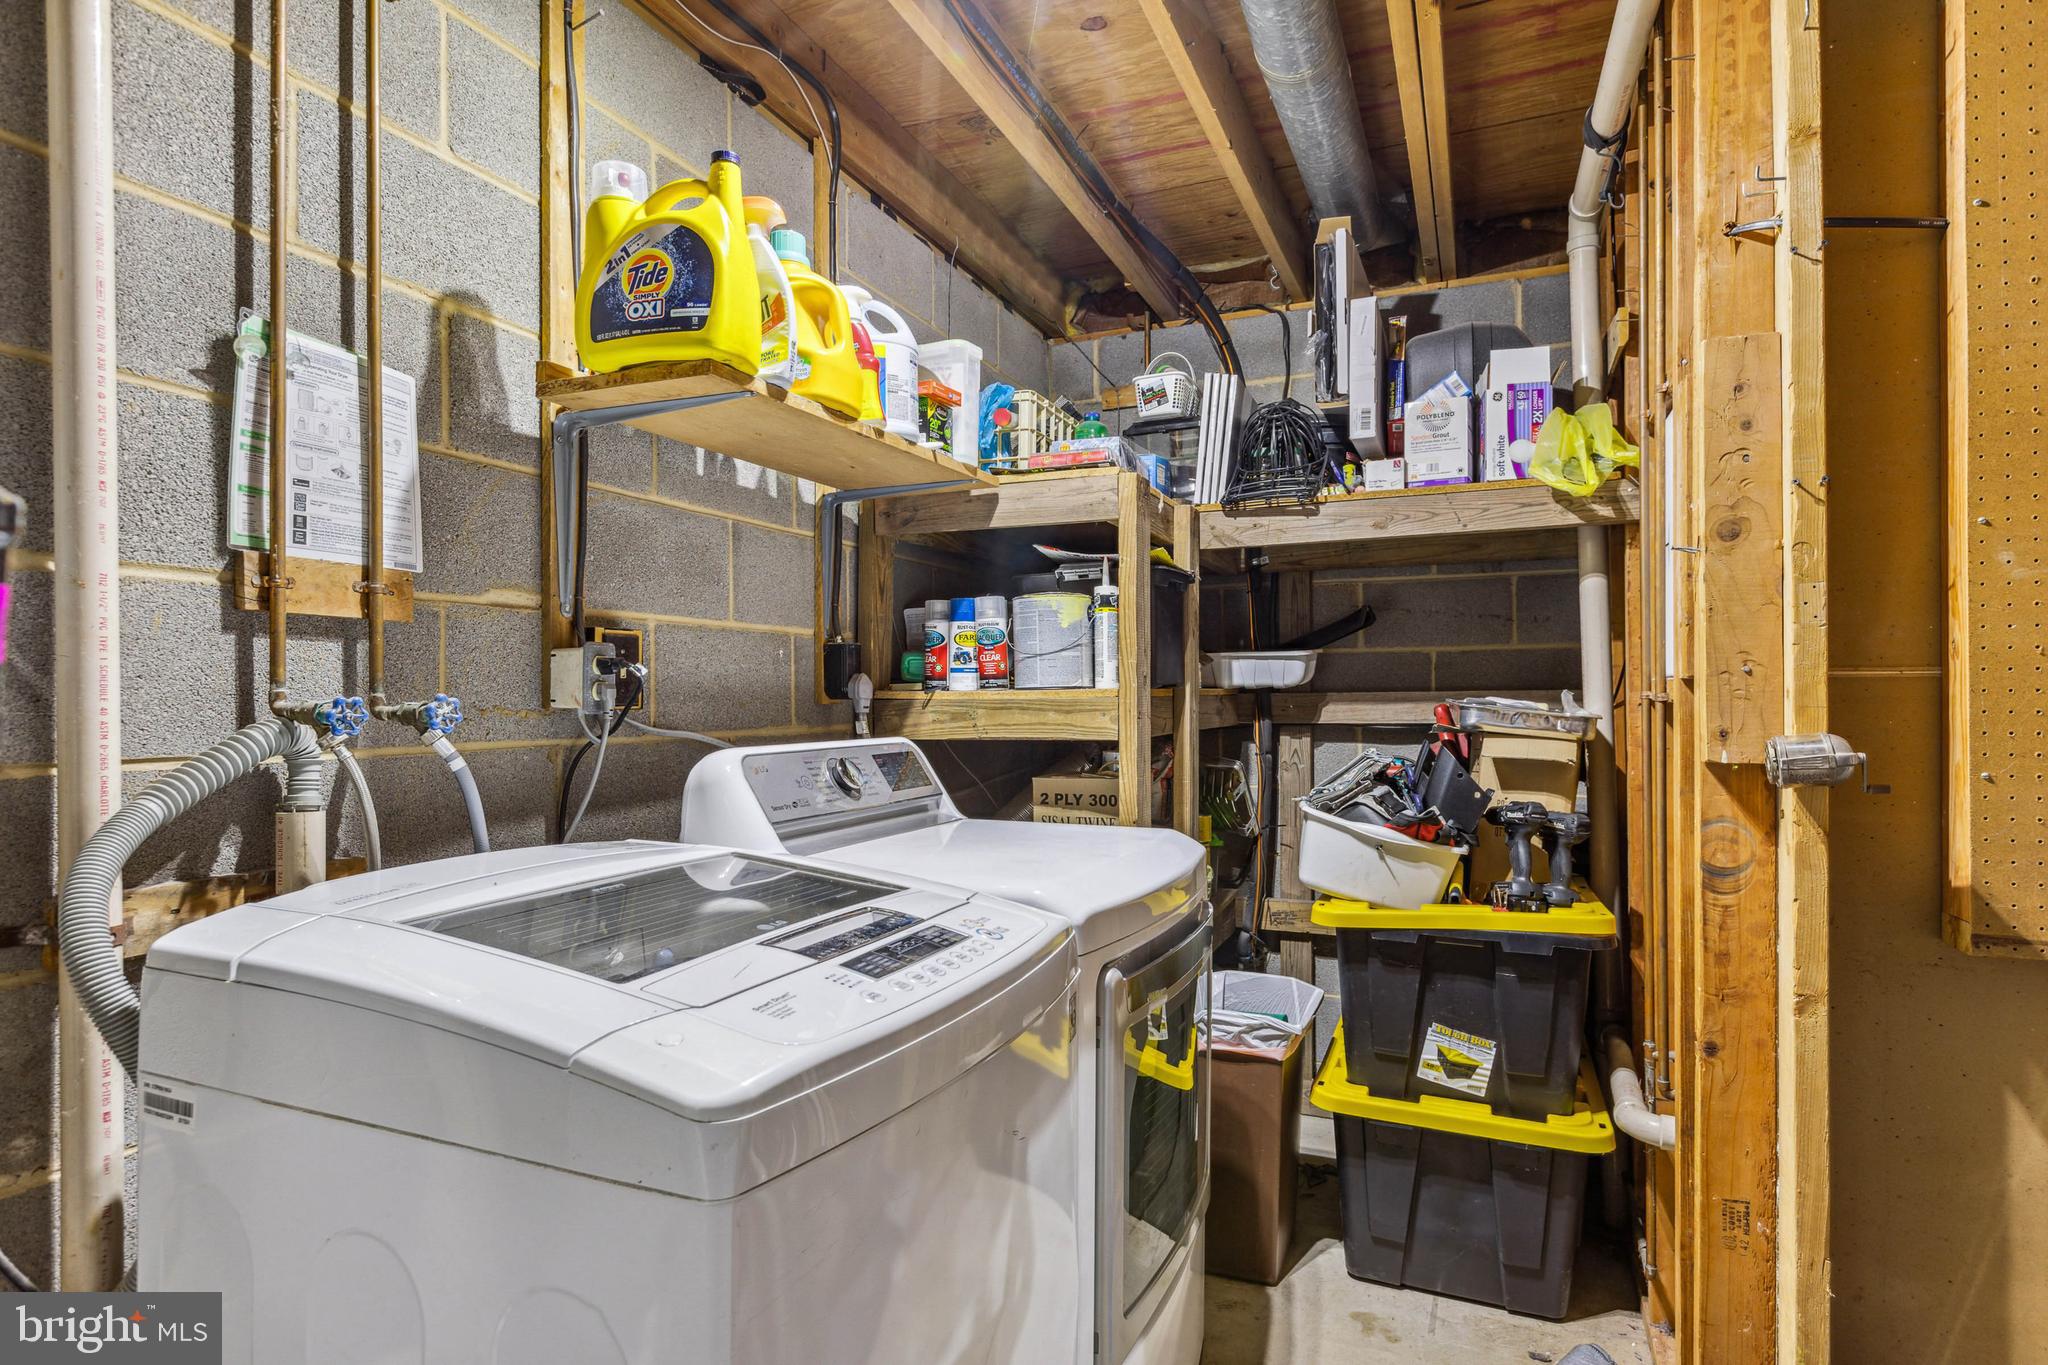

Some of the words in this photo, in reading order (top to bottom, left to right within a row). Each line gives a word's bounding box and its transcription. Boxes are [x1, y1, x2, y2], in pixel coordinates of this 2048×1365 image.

[628, 261, 668, 296] Tide
[634, 292, 660, 300] SIMPLY
[96, 306, 106, 321] PVC
[1416, 412, 1454, 420] POLYBLEND
[1533, 410, 1543, 423] 2X
[1497, 435, 1505, 458] white
[1497, 461, 1505, 476] soft
[99, 617, 108, 631] PVC
[99, 636, 108, 652] TYPE
[99, 665, 108, 702] SCHEDULE
[100, 707, 109, 716] 40
[100, 721, 109, 740] ASTM
[100, 745, 109, 771] D-2665
[100, 776, 109, 816] CHARLOTTE
[1040, 793, 1048, 804] 2
[1055, 793, 1083, 806] PLY
[1089, 794, 1118, 807] 300
[1436, 1024, 1468, 1042] TOUGH
[1471, 1034, 1491, 1048] BOX
[102, 1058, 112, 1078] ASTM
